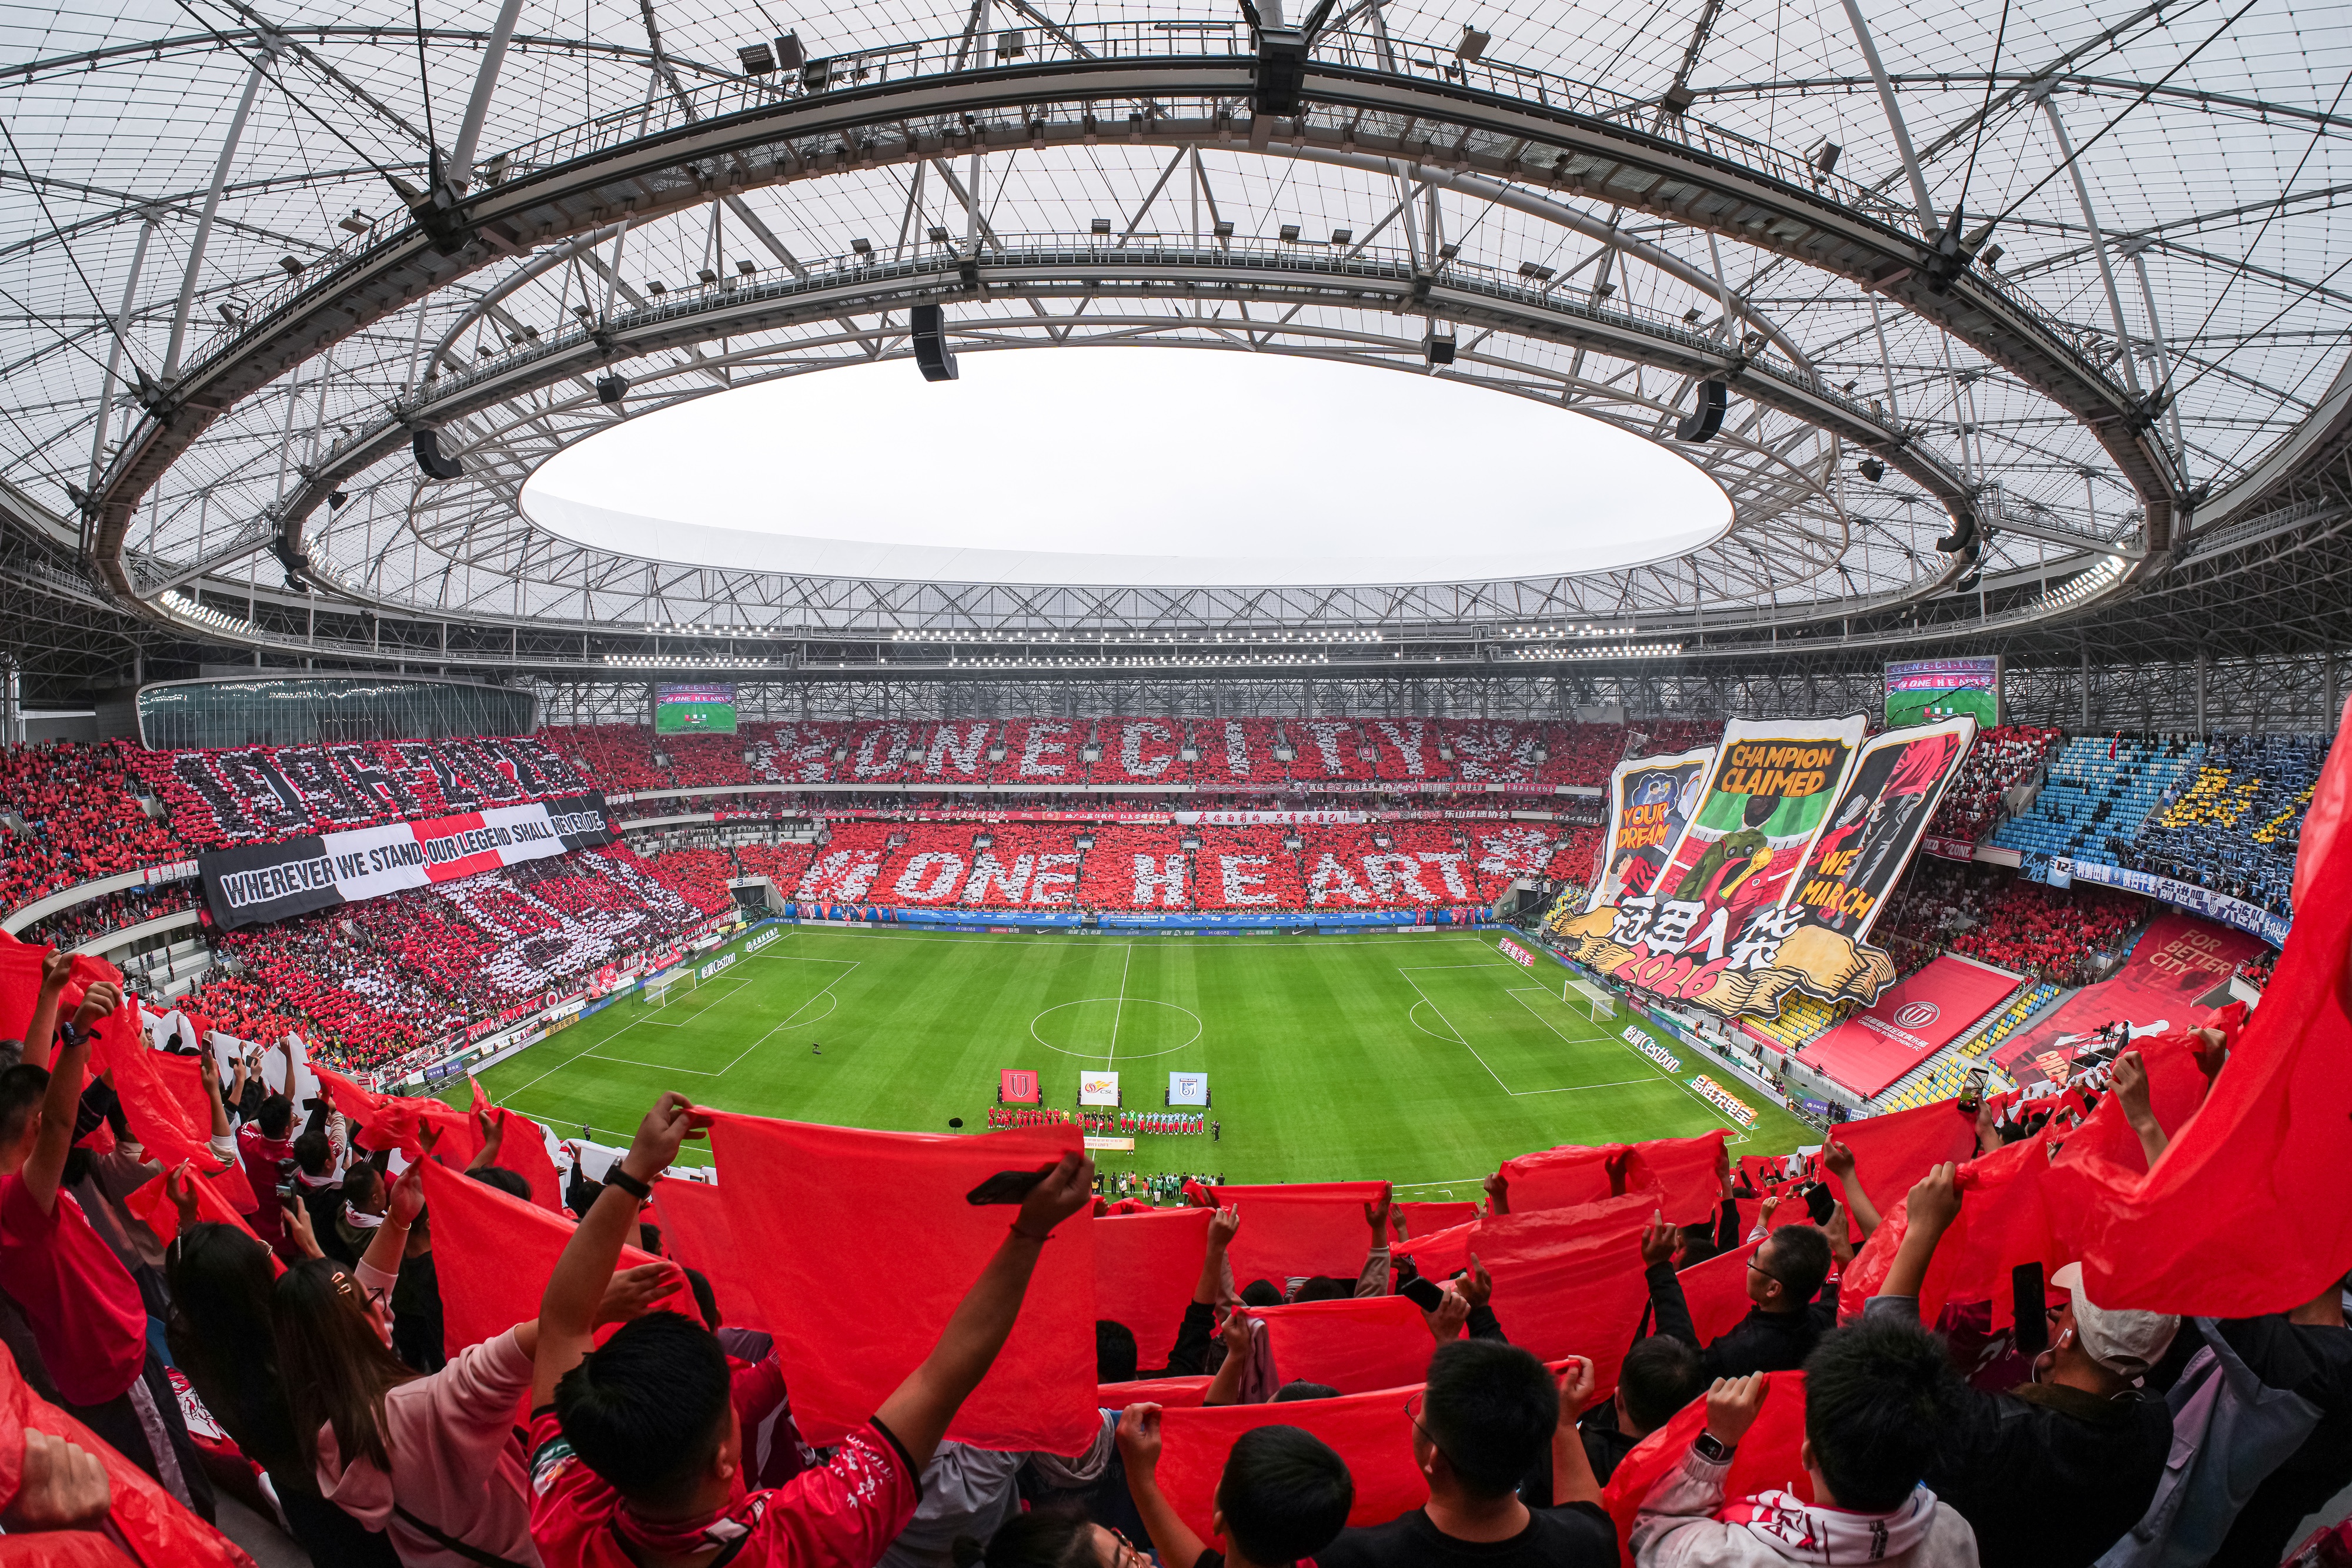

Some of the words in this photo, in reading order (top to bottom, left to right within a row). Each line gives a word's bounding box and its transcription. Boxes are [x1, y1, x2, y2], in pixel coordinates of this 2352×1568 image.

[1733, 745, 1835, 768] CHAMPION
[1722, 768, 1826, 797] CLAIMED
[941, 811, 1008, 820] 四川省球迷协会
[1444, 810, 1509, 819] 乐山球迷协会
[1622, 801, 1668, 827] YOUR
[1618, 823, 1671, 850] DREAM
[1923, 840, 1939, 851] RED
[1948, 843, 1972, 858] ZONE
[225, 858, 336, 907] WHEREVER
[336, 851, 369, 880] WE
[369, 843, 426, 875] STAND,
[426, 833, 460, 863] OUR
[459, 822, 513, 858] LEGEND
[512, 822, 554, 842] SHALL
[551, 813, 584, 837] NEVER
[583, 811, 605, 831] DIE.
[1818, 848, 1862, 876] WE
[2057, 860, 2070, 873] 12
[2076, 861, 2110, 883] 利剑出鞘
[893, 851, 1081, 904] ONE
[1134, 851, 1468, 905] HEART
[1796, 880, 1876, 921] MARCH
[2159, 878, 2205, 911] 前进吧
[2222, 900, 2264, 934] 大连队
[2179, 929, 2222, 952] FOR
[2262, 915, 2290, 945] 单刀赴会
[701, 963, 713, 979] 怡寶
[713, 952, 736, 971] C'estbon
[1502, 941, 1532, 967] 奕境汽车
[2149, 952, 2195, 977] CITY
[2164, 941, 2233, 976] BETTER
[1613, 940, 1733, 999] 2026
[1629, 1001, 1640, 1011] Lenovo
[1917, 1003, 1936, 1013] CHENGDU
[549, 1015, 576, 1034] 品胜充电宝
[1857, 1019, 1882, 1032] CHENGDU
[1880, 1030, 1913, 1048] RONGCHENG
[1862, 1015, 1929, 1048] 成都蓉城足球俱乐部
[1622, 1025, 1645, 1047] 怡寶
[1639, 1035, 1681, 1074] C'estbon
[1691, 1074, 1753, 1124] 品胜充电宝
